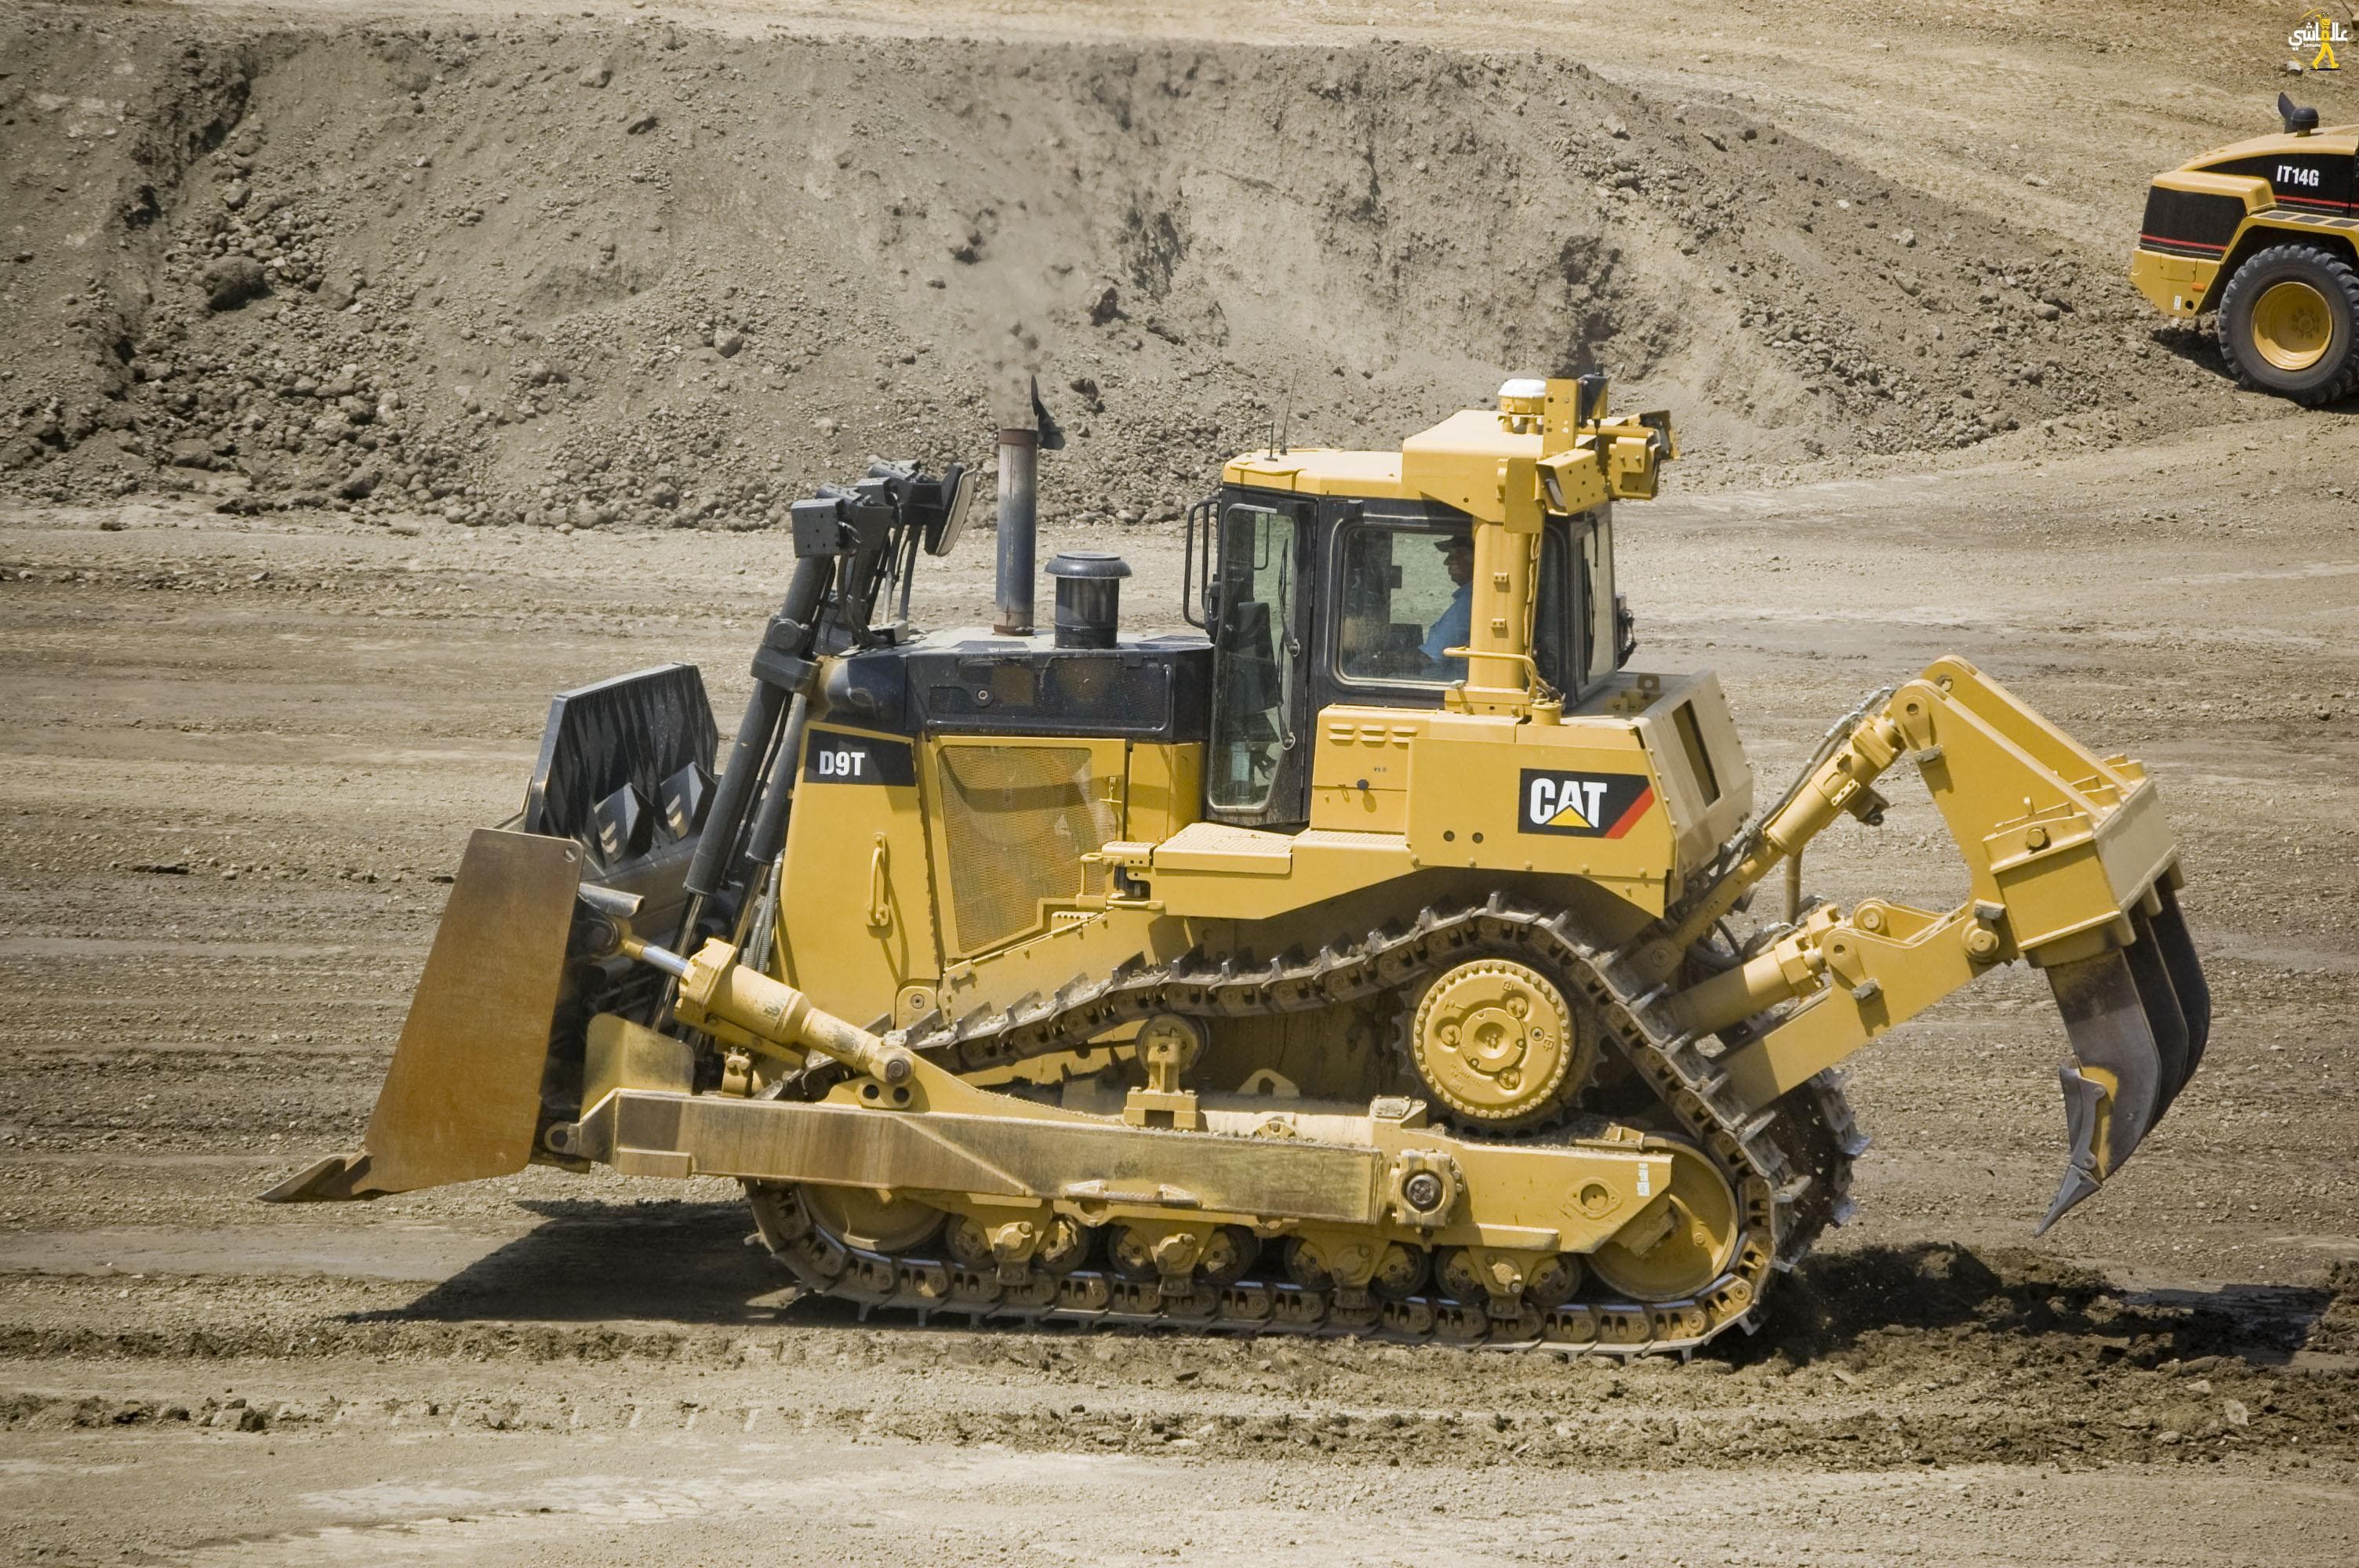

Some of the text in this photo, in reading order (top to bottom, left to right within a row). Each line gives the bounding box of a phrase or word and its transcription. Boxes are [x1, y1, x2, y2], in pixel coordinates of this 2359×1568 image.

[2277, 165, 2319, 187] IT14G
[819, 750, 866, 776] D9T
[1530, 778, 1608, 828] CAT
